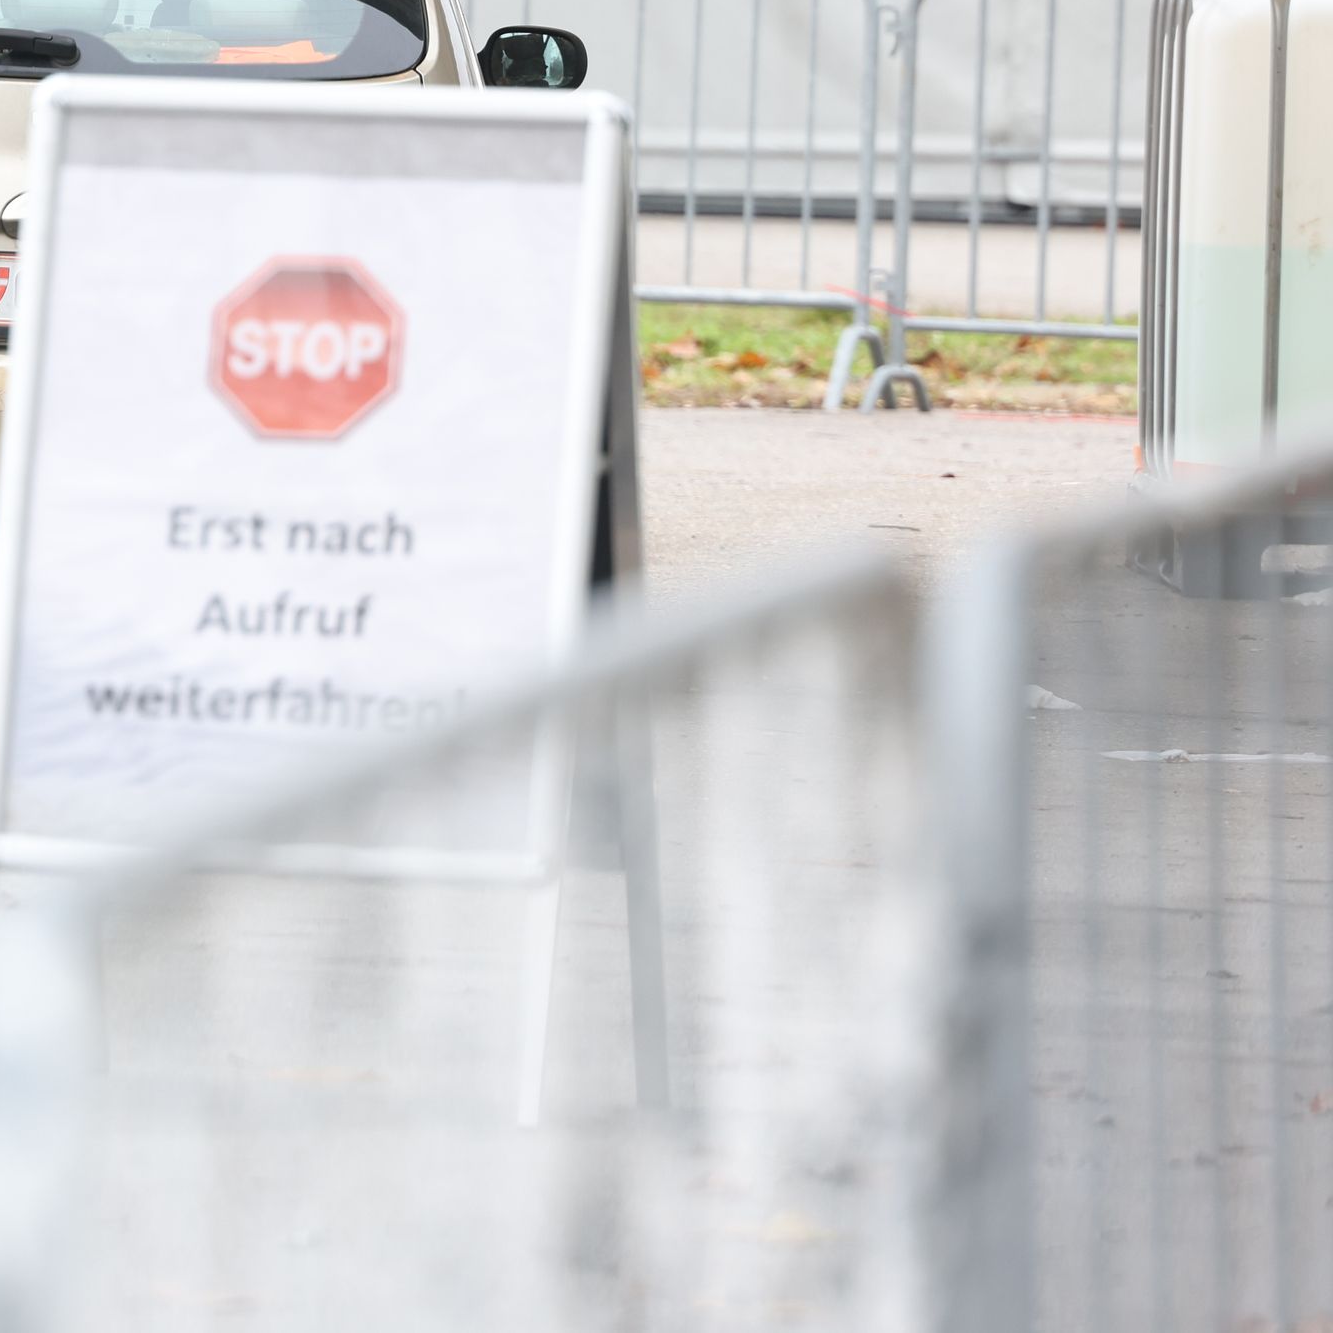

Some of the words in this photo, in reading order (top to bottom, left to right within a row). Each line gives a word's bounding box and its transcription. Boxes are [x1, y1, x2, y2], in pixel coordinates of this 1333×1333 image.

[228, 320, 388, 378] STOP
[166, 504, 267, 550] Erst
[286, 512, 415, 555] nach
[195, 592, 373, 638] Aufruf
